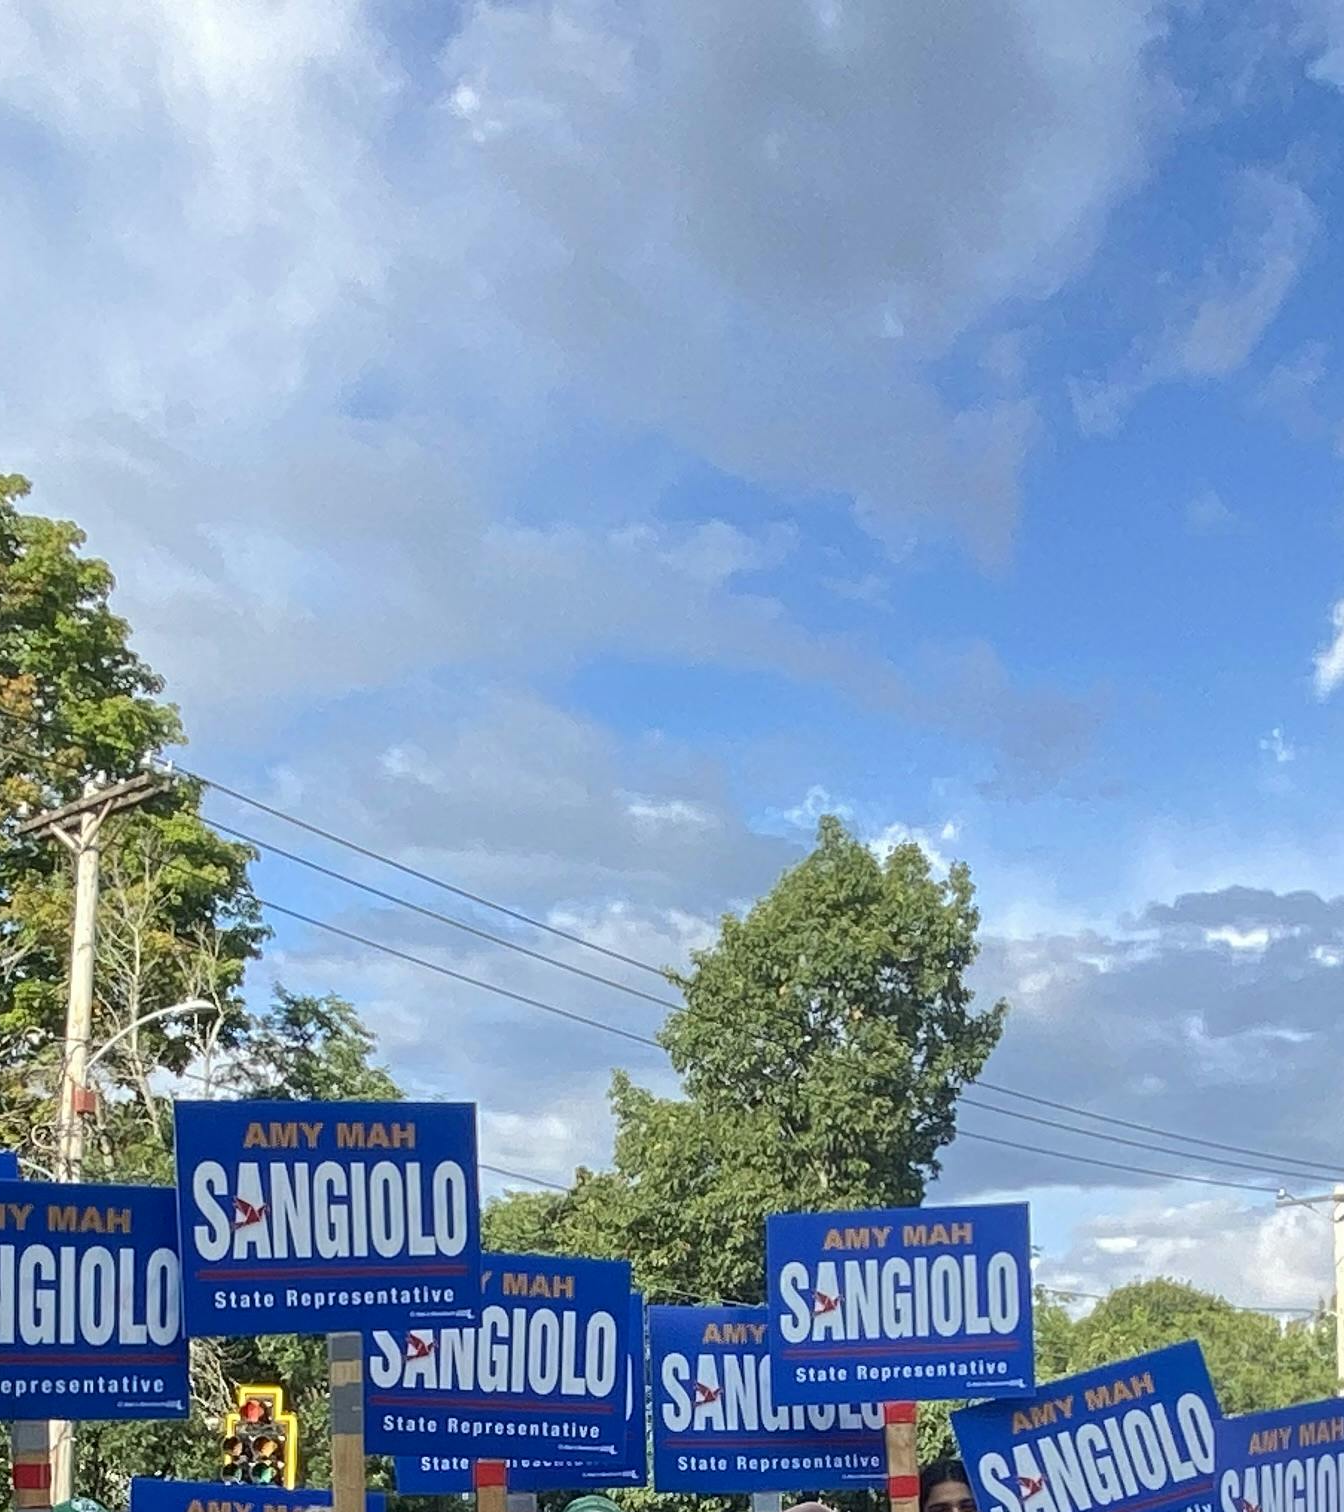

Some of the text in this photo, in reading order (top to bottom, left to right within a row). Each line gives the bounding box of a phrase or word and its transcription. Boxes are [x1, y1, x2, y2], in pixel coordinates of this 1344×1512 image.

[243, 1122, 416, 1149] AMY MAH
[48, 1205, 132, 1233] MAH
[192, 1160, 468, 1261] SANGIOLO
[823, 1223, 973, 1250] AMY MAH
[214, 1286, 454, 1309] State Representative
[503, 1273, 575, 1298] MAH
[779, 1251, 1019, 1344] SANGIOLO
[703, 1323, 766, 1345] AMY
[370, 1305, 617, 1398] SANGIOLO
[795, 1360, 1008, 1382] State Representative
[1012, 1372, 1155, 1435] AMY MAH
[383, 1415, 600, 1438] State Representative
[1248, 1416, 1344, 1456] AMY MAH
[421, 1457, 469, 1471] State
[678, 1453, 881, 1473] State Representative
